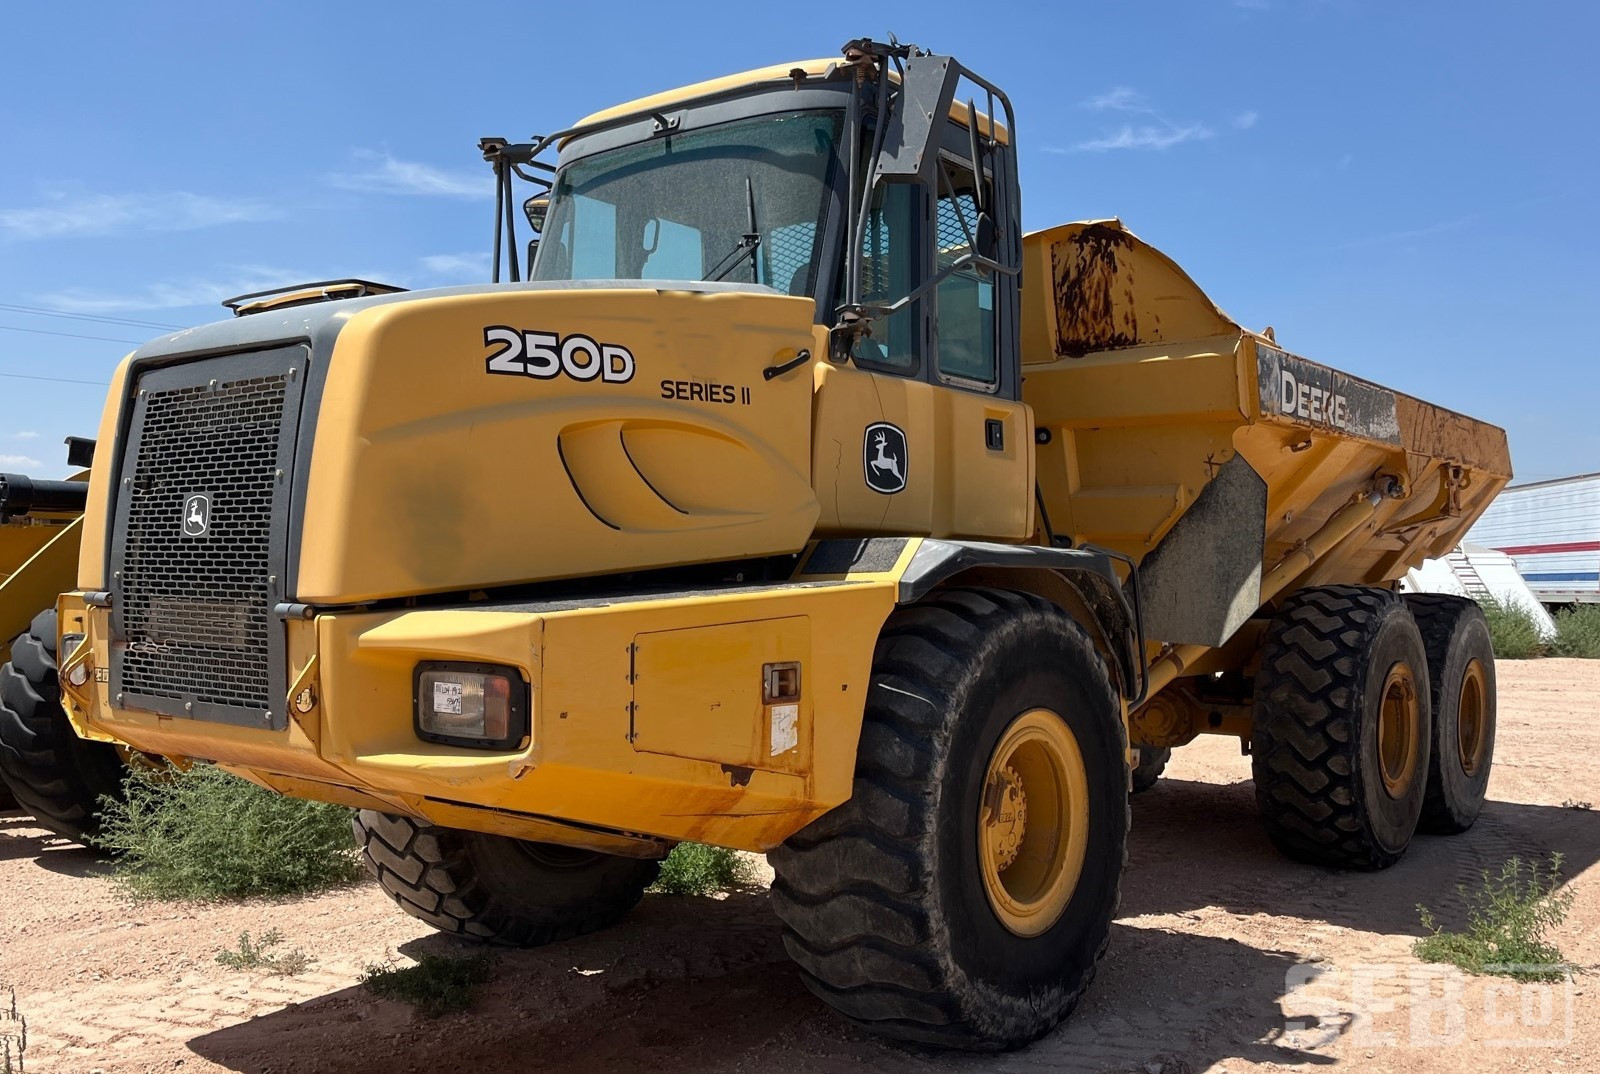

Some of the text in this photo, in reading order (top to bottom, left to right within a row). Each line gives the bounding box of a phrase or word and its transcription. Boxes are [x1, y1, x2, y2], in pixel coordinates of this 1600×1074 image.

[484, 325, 636, 384] 250D
[660, 379, 751, 405] SERIES II
[1281, 369, 1346, 428] DEERE
